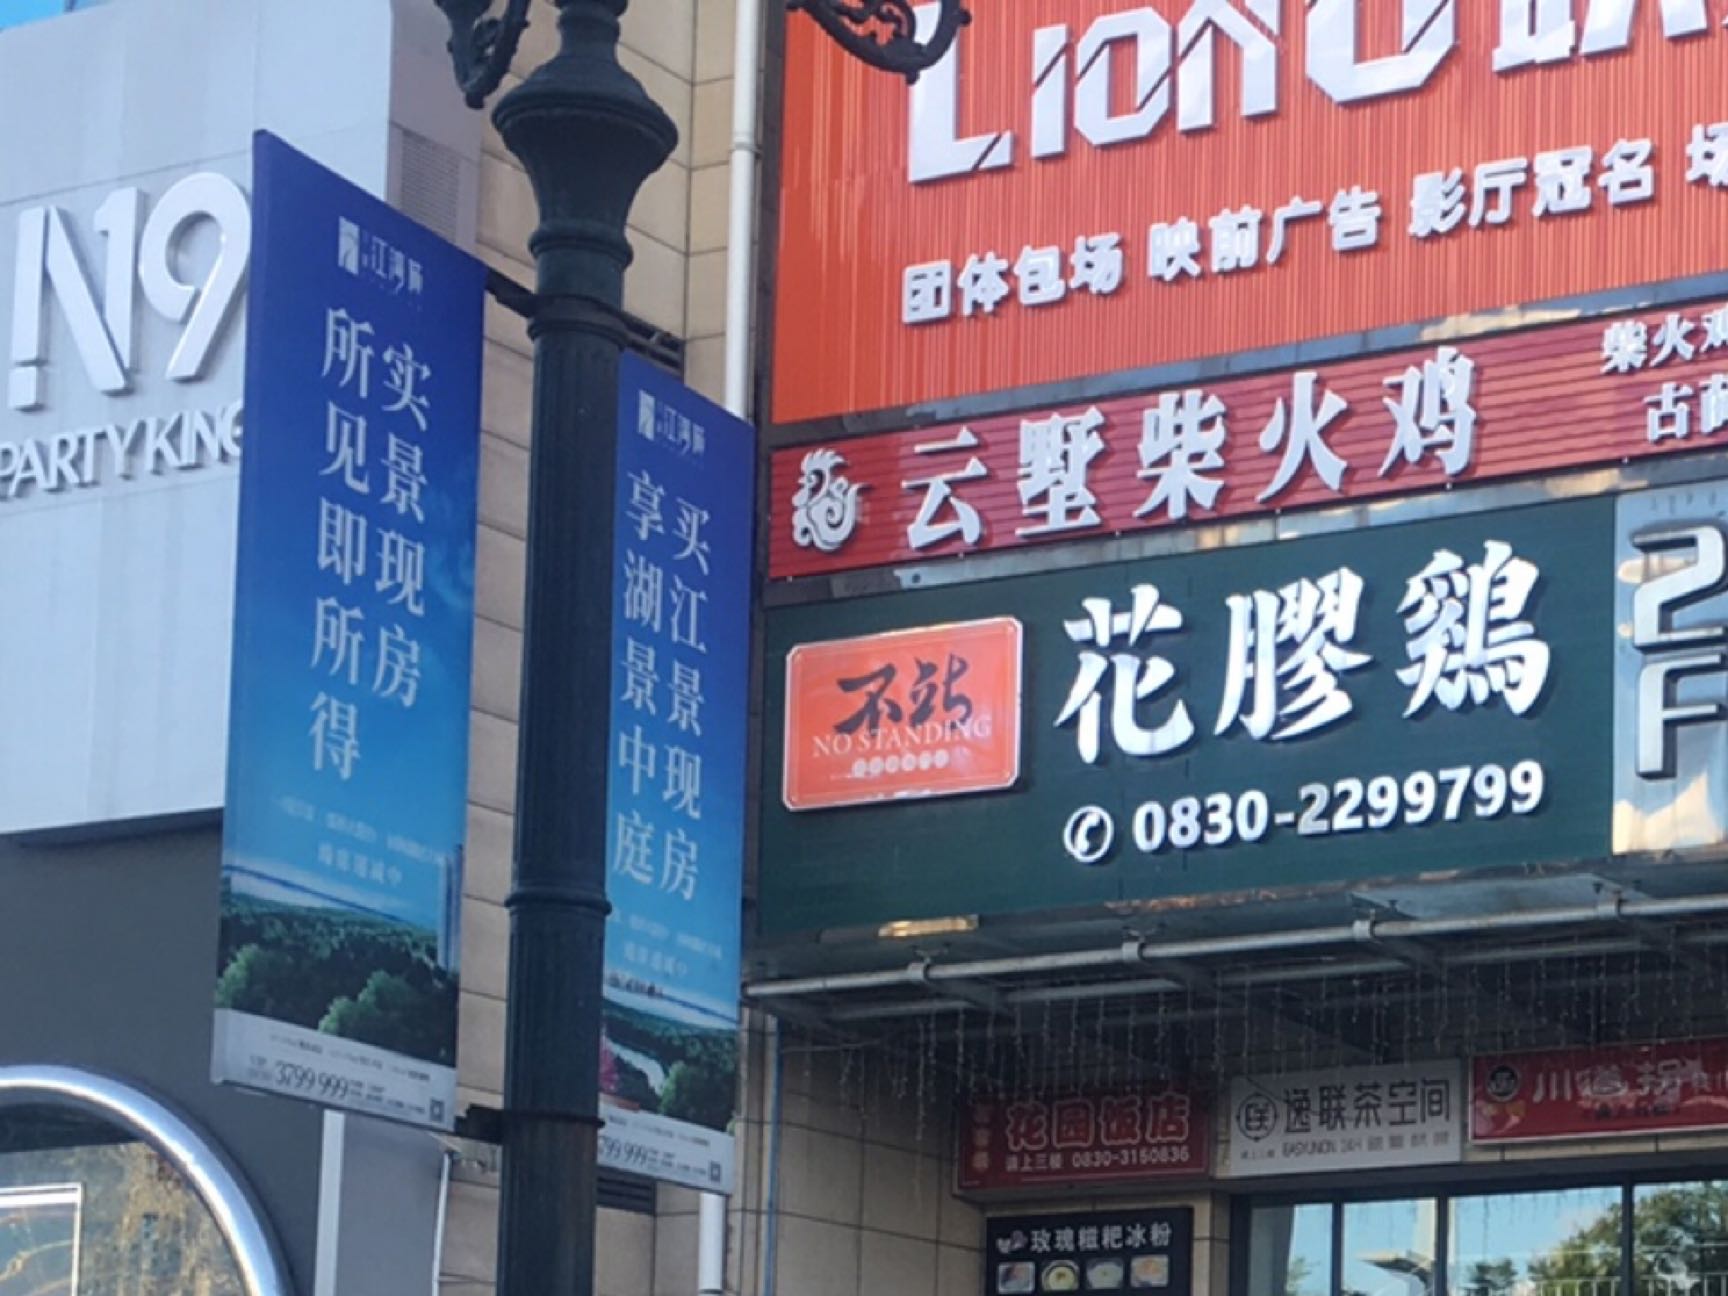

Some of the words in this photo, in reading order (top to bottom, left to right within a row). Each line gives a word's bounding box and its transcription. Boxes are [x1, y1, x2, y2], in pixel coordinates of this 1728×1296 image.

[902, 232, 1123, 325] 团体包场
[1147, 186, 1382, 281] 映前广告
[1409, 139, 1655, 238] 影厅冠名
[307, 307, 376, 780] 所见即所得
[373, 344, 432, 708] 实景现房
[900, 346, 1477, 549] 云墅柴火鸡
[612, 470, 668, 885] 享湖景中庭
[660, 497, 711, 901] 买江景现房
[811, 733, 853, 758] NO
[856, 714, 993, 751] STANDING
[1132, 759, 1545, 851] 0830-2299799
[1005, 1091, 1191, 1151] 花园饭店
